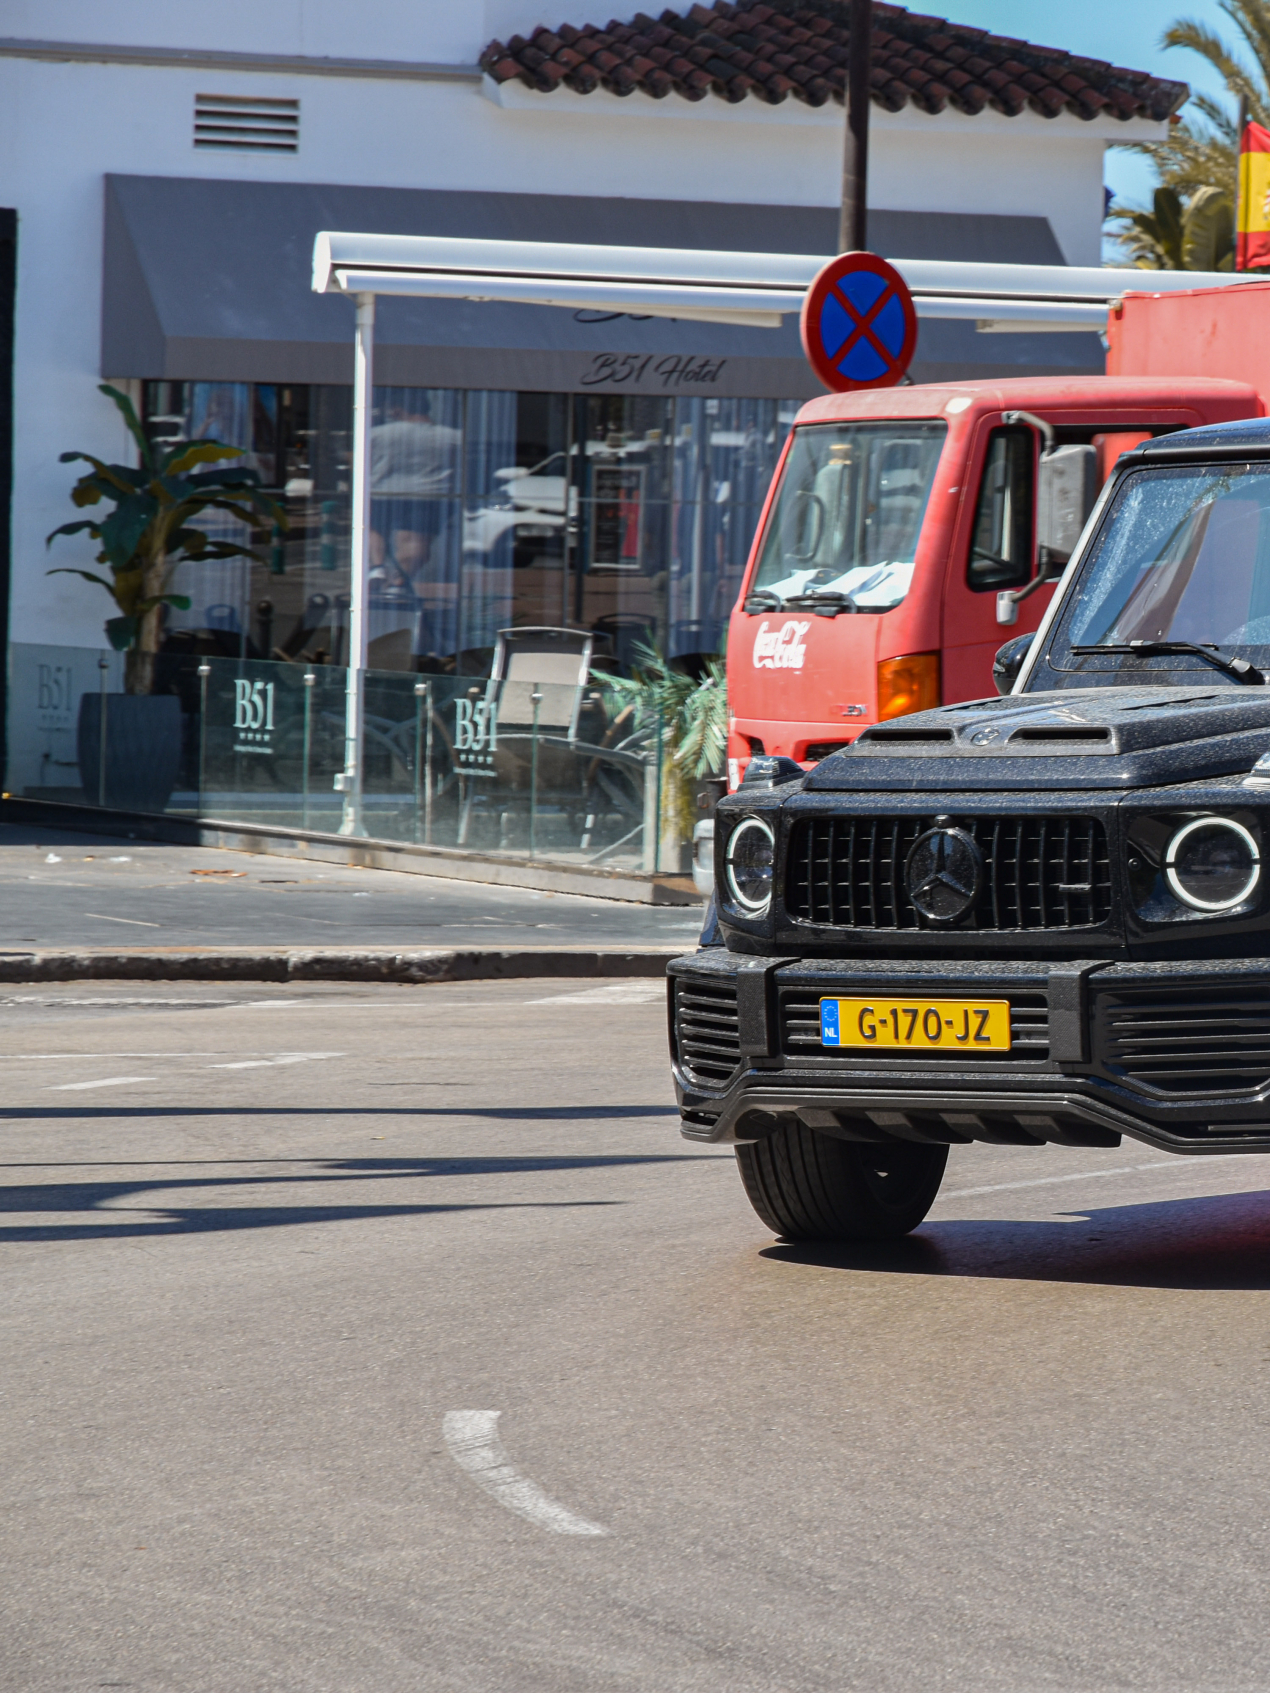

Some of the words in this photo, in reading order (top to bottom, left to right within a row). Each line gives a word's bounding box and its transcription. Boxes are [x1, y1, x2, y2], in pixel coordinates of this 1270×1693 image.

[580, 352, 654, 386] B51
[654, 355, 728, 388] Hotel
[232, 678, 275, 730] B51
[452, 698, 498, 752] B51
[824, 1027, 838, 1038] NL
[857, 1006, 992, 1043] G-170-JZ
